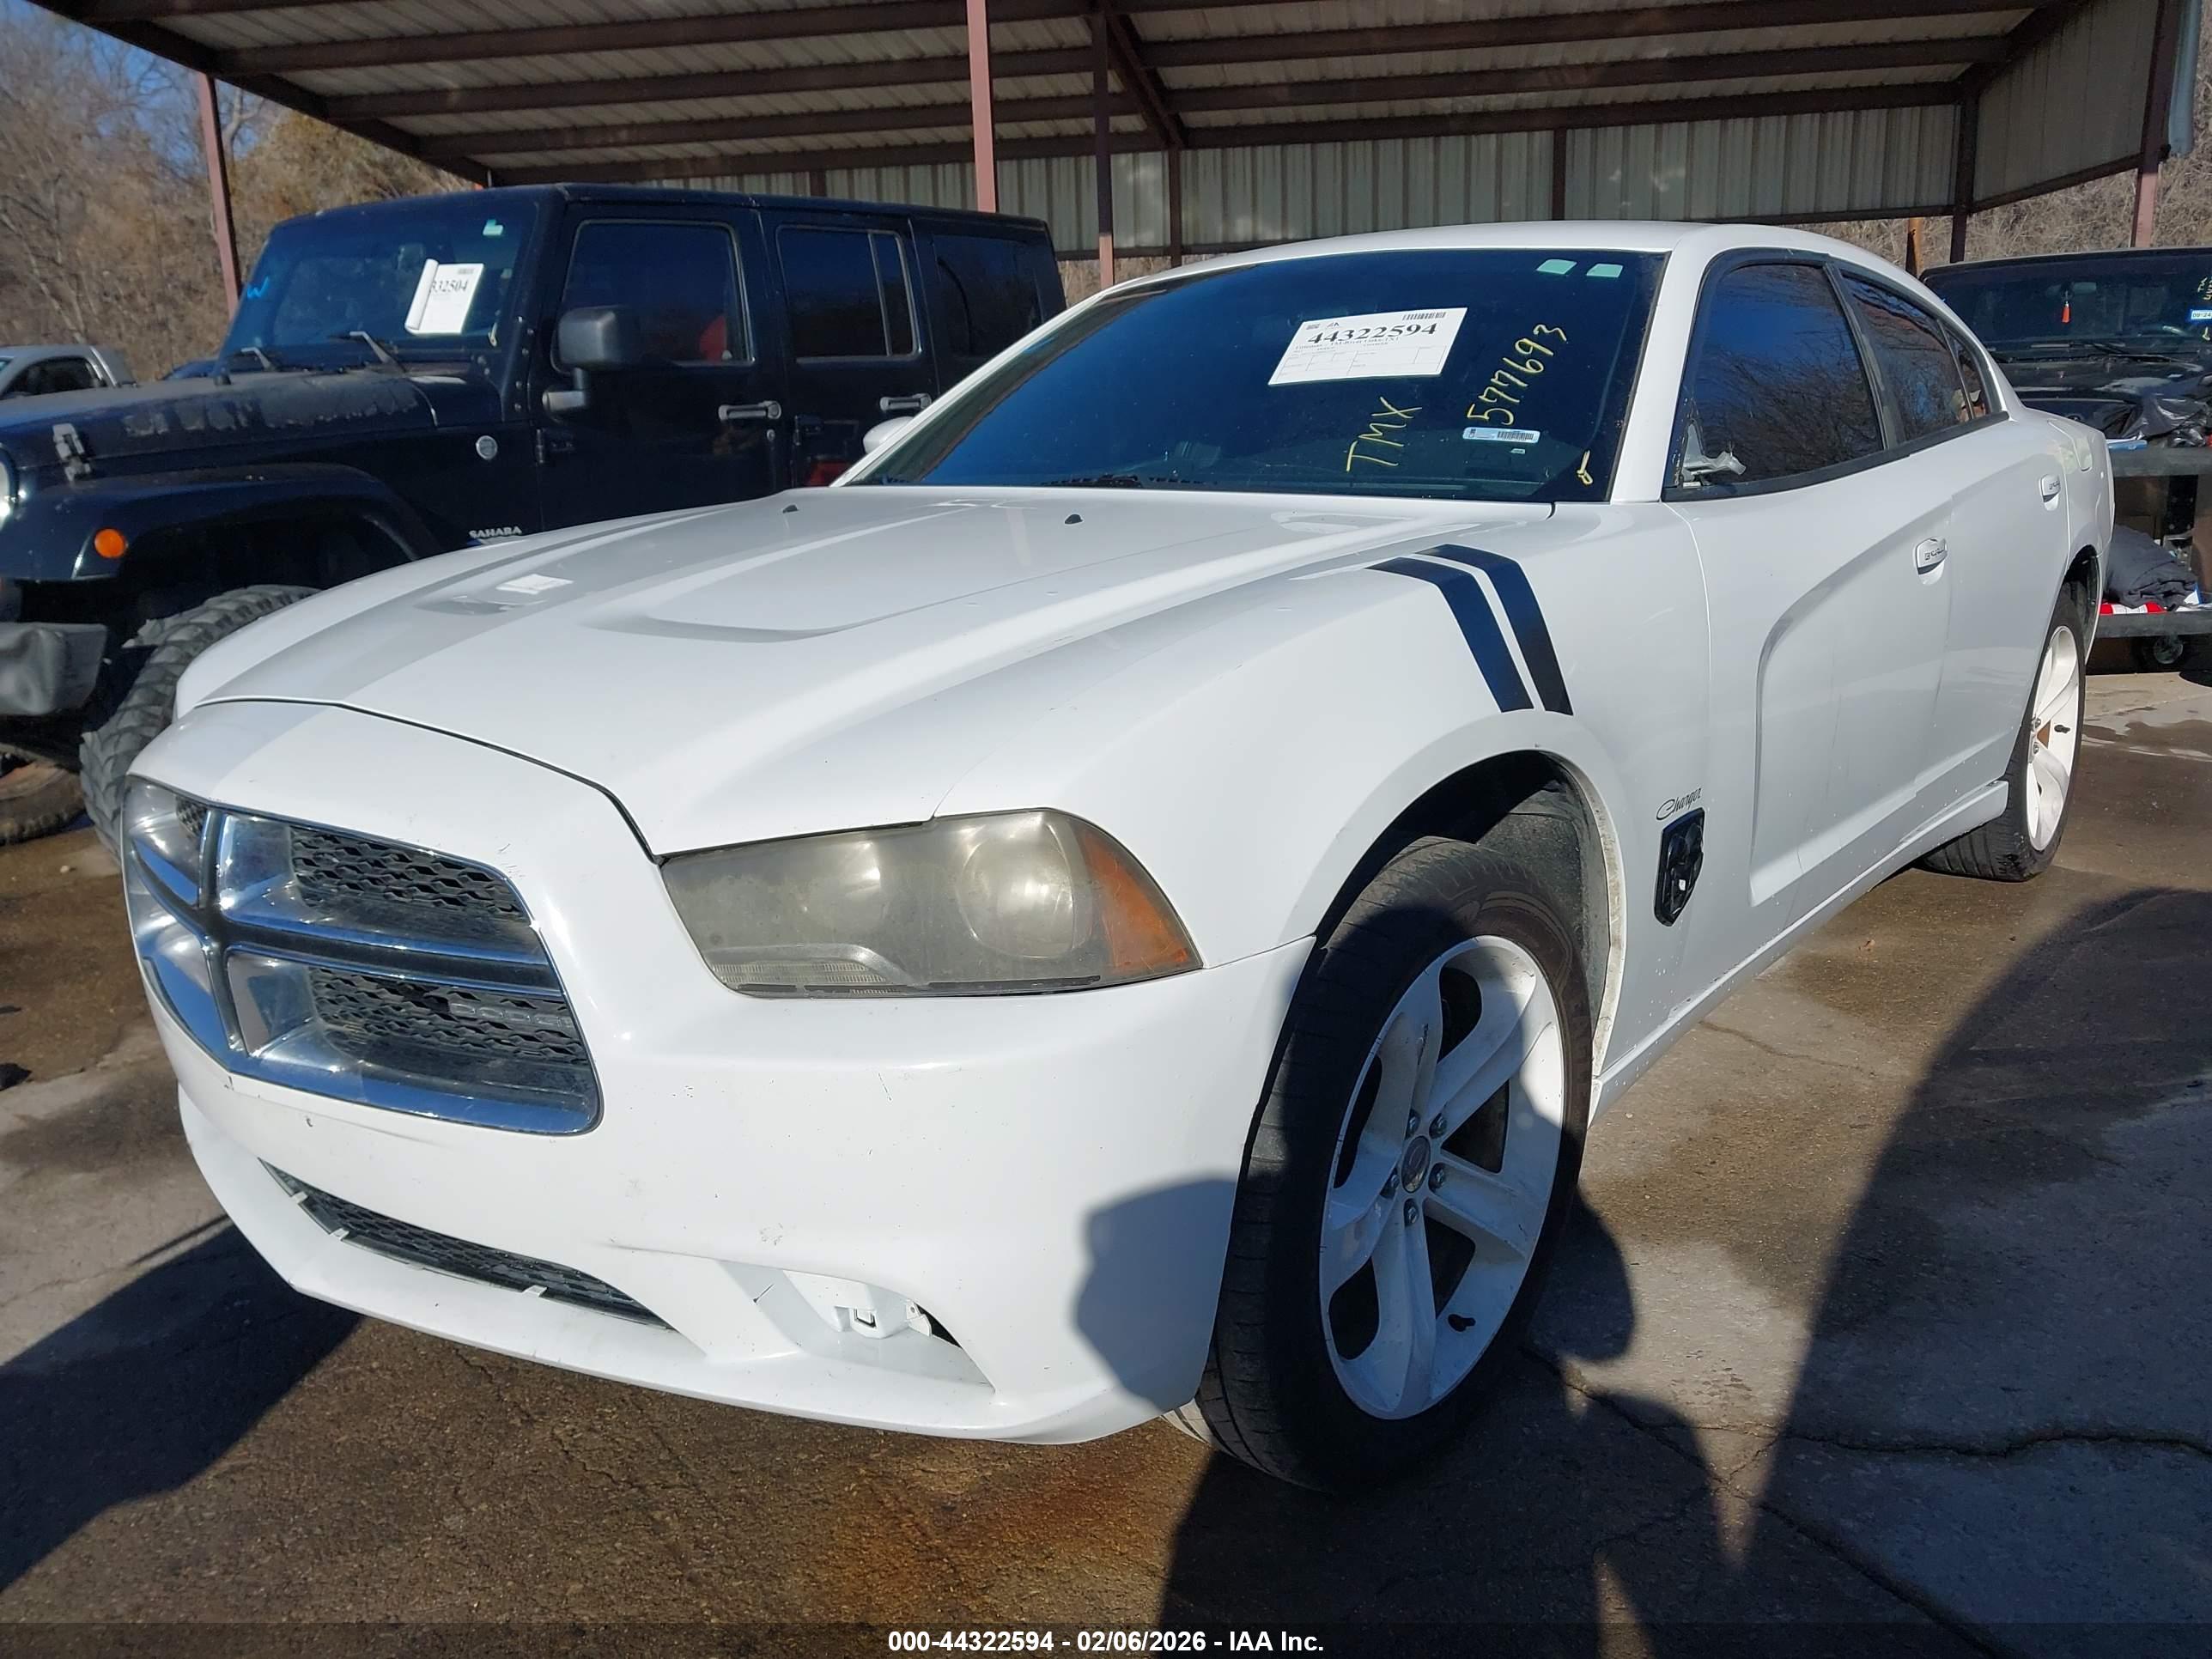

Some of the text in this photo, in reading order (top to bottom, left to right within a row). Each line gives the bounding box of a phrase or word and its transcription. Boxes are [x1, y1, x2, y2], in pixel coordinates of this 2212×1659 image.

[1307, 322, 1438, 344] 44322594
[1346, 396, 1423, 471] TMX
[468, 526, 522, 538] SAHARA
[1656, 787, 1702, 821] Charger
